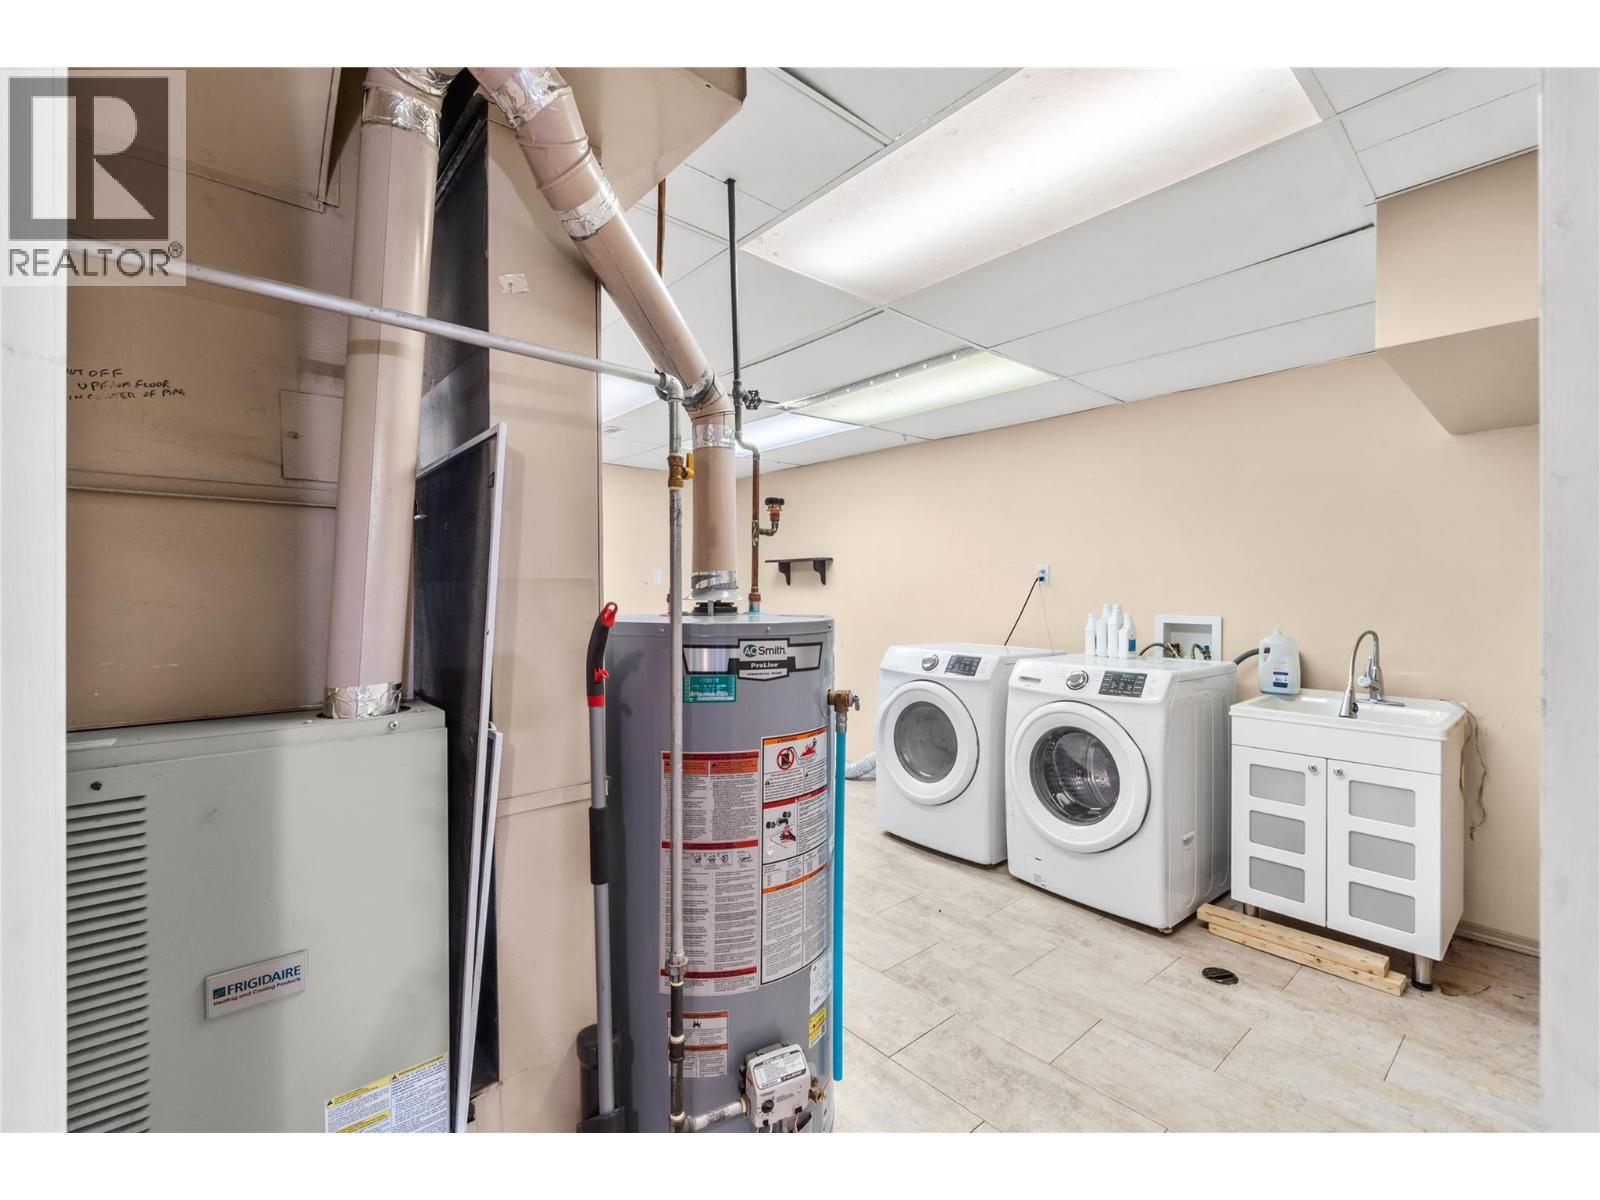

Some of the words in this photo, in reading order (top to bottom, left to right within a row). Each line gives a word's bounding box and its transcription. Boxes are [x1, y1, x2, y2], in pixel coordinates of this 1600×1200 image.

[67, 368, 84, 376] UT
[88, 368, 122, 377] OFF
[77, 381, 100, 391] UP
[135, 379, 171, 388] FLOOR
[143, 390, 156, 398] OF
[162, 388, 186, 397] PIPE
[758, 645, 786, 655] Smith
[227, 965, 301, 995] FRIGIDAIRE
[213, 995, 238, 1006] Heating
[239, 991, 252, 999] and
[253, 985, 276, 995] Cooling
[277, 978, 301, 987] Products
